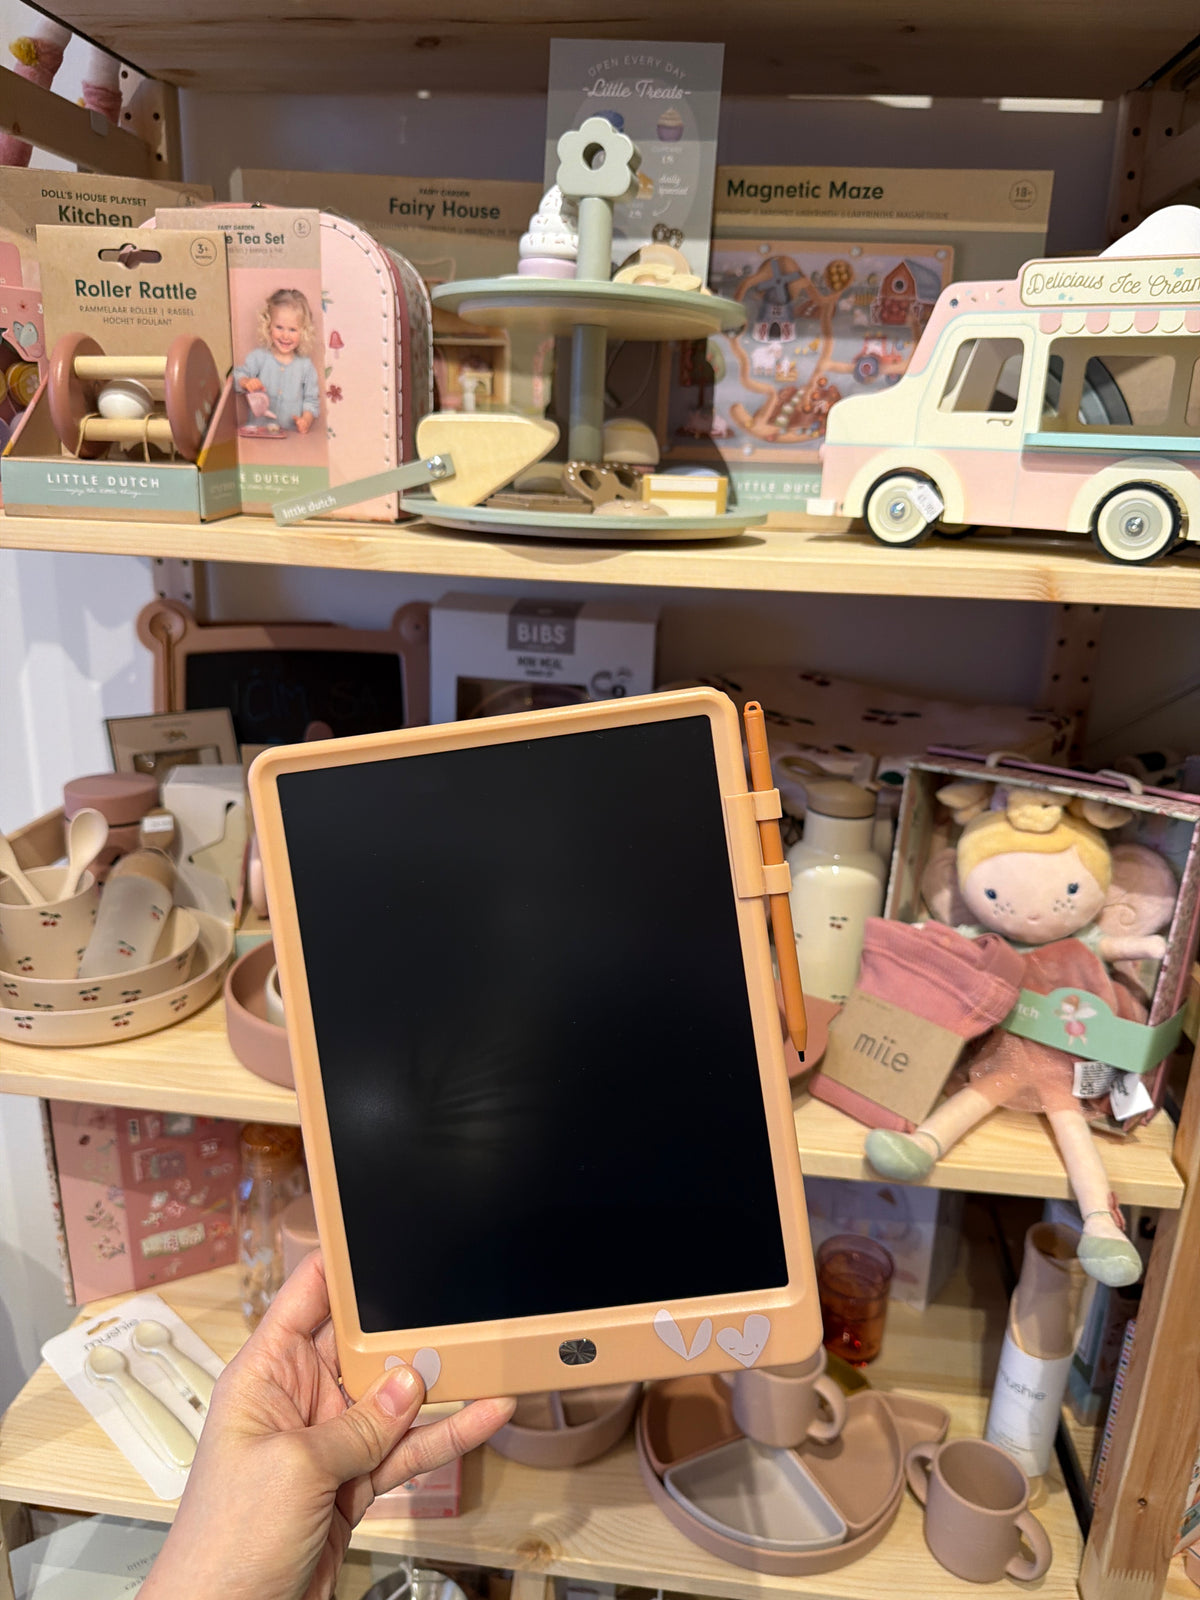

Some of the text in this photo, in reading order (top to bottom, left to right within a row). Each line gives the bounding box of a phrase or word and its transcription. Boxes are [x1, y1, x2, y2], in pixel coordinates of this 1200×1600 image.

[588, 55, 686, 80] OPEN EVERY DAY
[41, 189, 147, 207] DOLL'S HOUSE PLAYSET
[727, 179, 884, 203] Magnetic Maze
[58, 205, 133, 227] Kitchen
[389, 197, 500, 221] Fairy House
[237, 232, 260, 244] Tea
[264, 232, 285, 245] Set
[74, 279, 197, 300] Roller Rattle
[1026, 271, 1104, 296] Delicious
[1109, 273, 1142, 294] Ice
[130, 306, 158, 315] ROLLER
[47, 473, 160, 488] LITTLE DUTCH
[254, 472, 300, 485] DUTCH
[737, 480, 820, 494] ITTLE DUTC
[282, 494, 337, 520] little dutch
[517, 622, 567, 645] BIBS
[1017, 1003, 1039, 1020] tch
